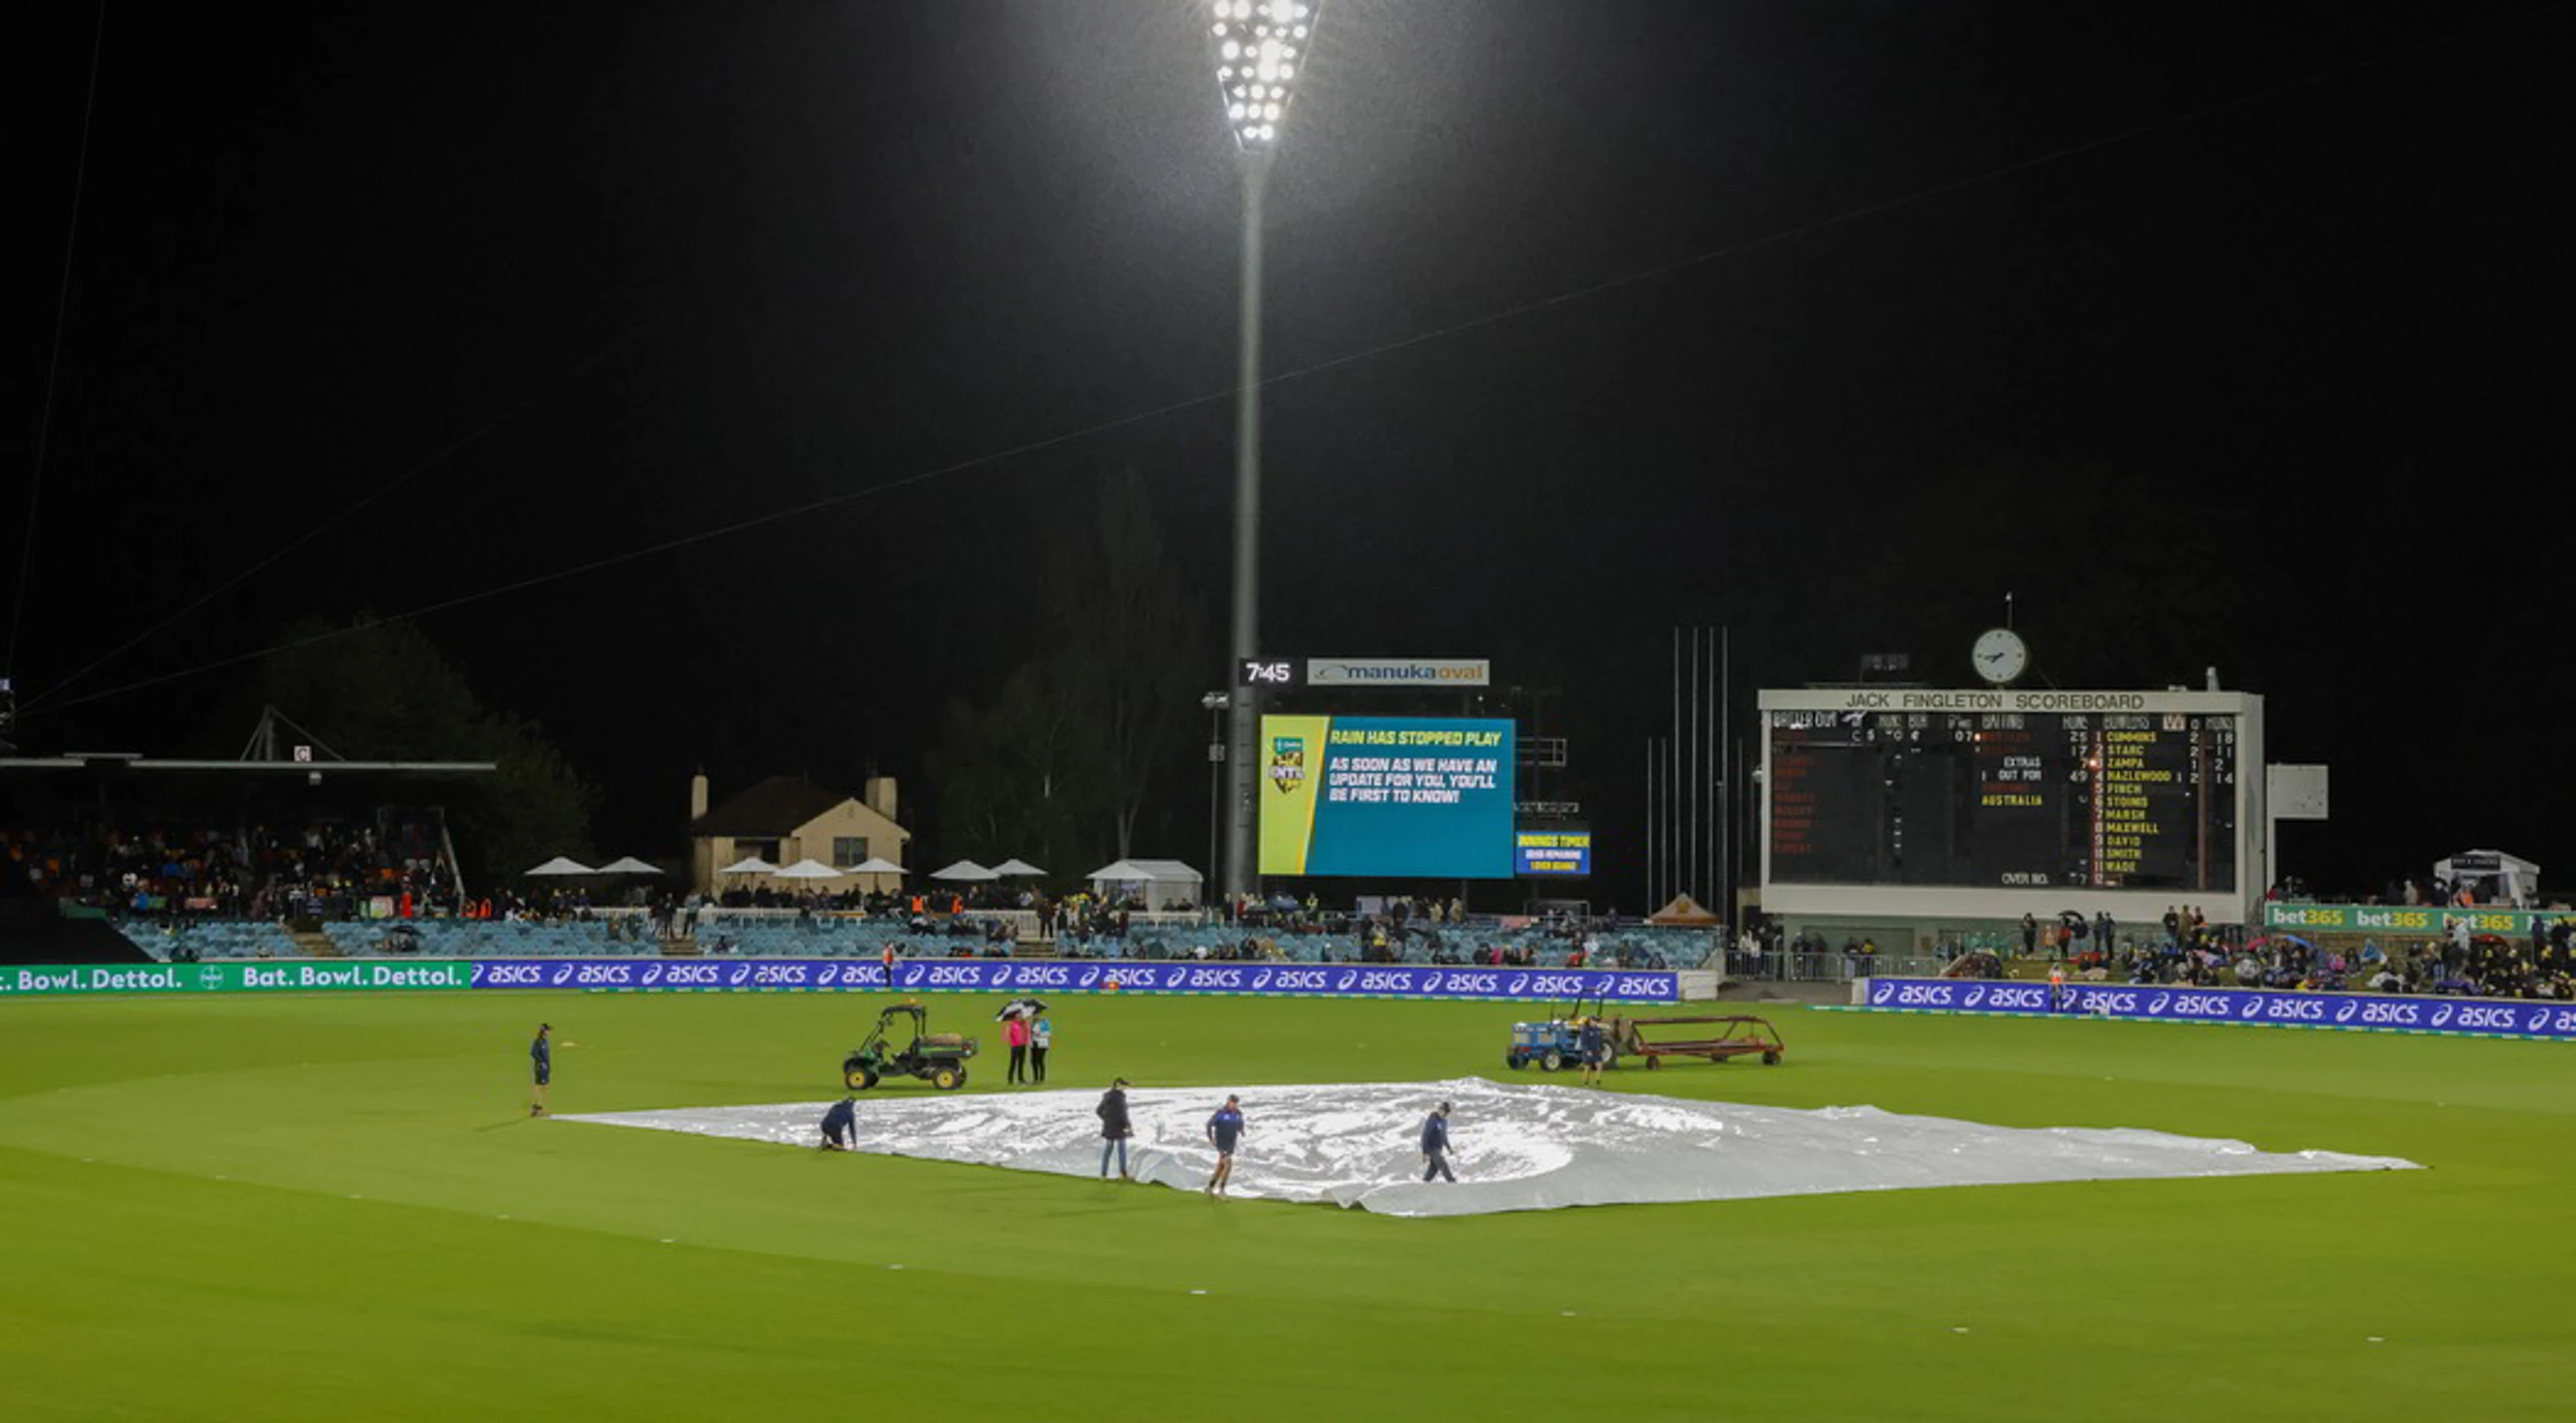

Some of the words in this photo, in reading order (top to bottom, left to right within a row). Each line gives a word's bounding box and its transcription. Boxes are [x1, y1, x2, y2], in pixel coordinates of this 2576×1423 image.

[1245, 662, 1291, 683] 7:45
[1847, 693, 1890, 708] JACK
[1903, 694, 2002, 708] FINGLETON
[2015, 694, 2145, 709] SCOREBOARD
[1330, 730, 1365, 744] RAIN
[1366, 730, 1396, 745] HAS
[1397, 731, 1464, 745] STOPPED
[1464, 731, 1503, 746] PLAY
[2106, 731, 2157, 743] CUMMINS
[2106, 745, 2145, 756] STARC
[1330, 758, 1350, 772] AS
[1350, 758, 1389, 772] SOON
[1390, 759, 1412, 772] AS
[1413, 759, 1437, 773] WE
[1438, 759, 1474, 773] HAVE
[1475, 759, 1498, 774] AN
[2003, 755, 2042, 768] EXTRAS
[2106, 757, 2145, 769] ZAMPA
[1330, 773, 1383, 786] UPDATE
[1385, 774, 1413, 787] FOR
[1449, 774, 1497, 788] YOU'LL
[1998, 770, 2018, 782] OUT
[2023, 770, 2042, 782] FOR
[2106, 770, 2171, 782] HAZLEWOOD
[1330, 788, 1348, 801] BE
[1350, 788, 1389, 802] FIRST
[1392, 788, 1411, 802] TO
[1412, 788, 1462, 803] KNOW!
[2106, 783, 2143, 794] FINCH
[1982, 794, 2043, 806] AUSTRALIA
[2106, 796, 2149, 808] STOINIS
[2106, 809, 2146, 821] MARSH
[2106, 822, 2160, 835] MAXWELL
[2106, 835, 2141, 847] DAVID
[2106, 849, 2143, 860] SMITH
[2106, 861, 2138, 872] WADE
[2001, 872, 2029, 885] OVER
[2273, 908, 2344, 925] bet365
[2357, 910, 2428, 928] bet365
[19, 969, 87, 990] Bowl.
[93, 967, 182, 990] Dettol.
[244, 967, 294, 988] Bat.
[301, 966, 368, 987] Bowl.
[373, 966, 462, 987] Dettol.
[488, 966, 541, 982] asics
[578, 966, 631, 982] asics
[666, 966, 720, 982] asics
[754, 966, 808, 983] asics
[929, 967, 980, 984] asics
[1015, 967, 1068, 985] asics
[1189, 969, 1243, 987] asics
[1275, 971, 1326, 988] asics
[1360, 972, 1411, 990] asics
[1446, 973, 1497, 992] asics
[1532, 976, 1583, 994] asics
[1618, 977, 1670, 996] asics
[1898, 986, 1952, 1005] asics
[1989, 988, 2043, 1008] asics
[2175, 995, 2230, 1015] asics
[2268, 998, 2324, 1019] asics
[2362, 1002, 2418, 1023] asics
[2458, 1006, 2516, 1027] asics
